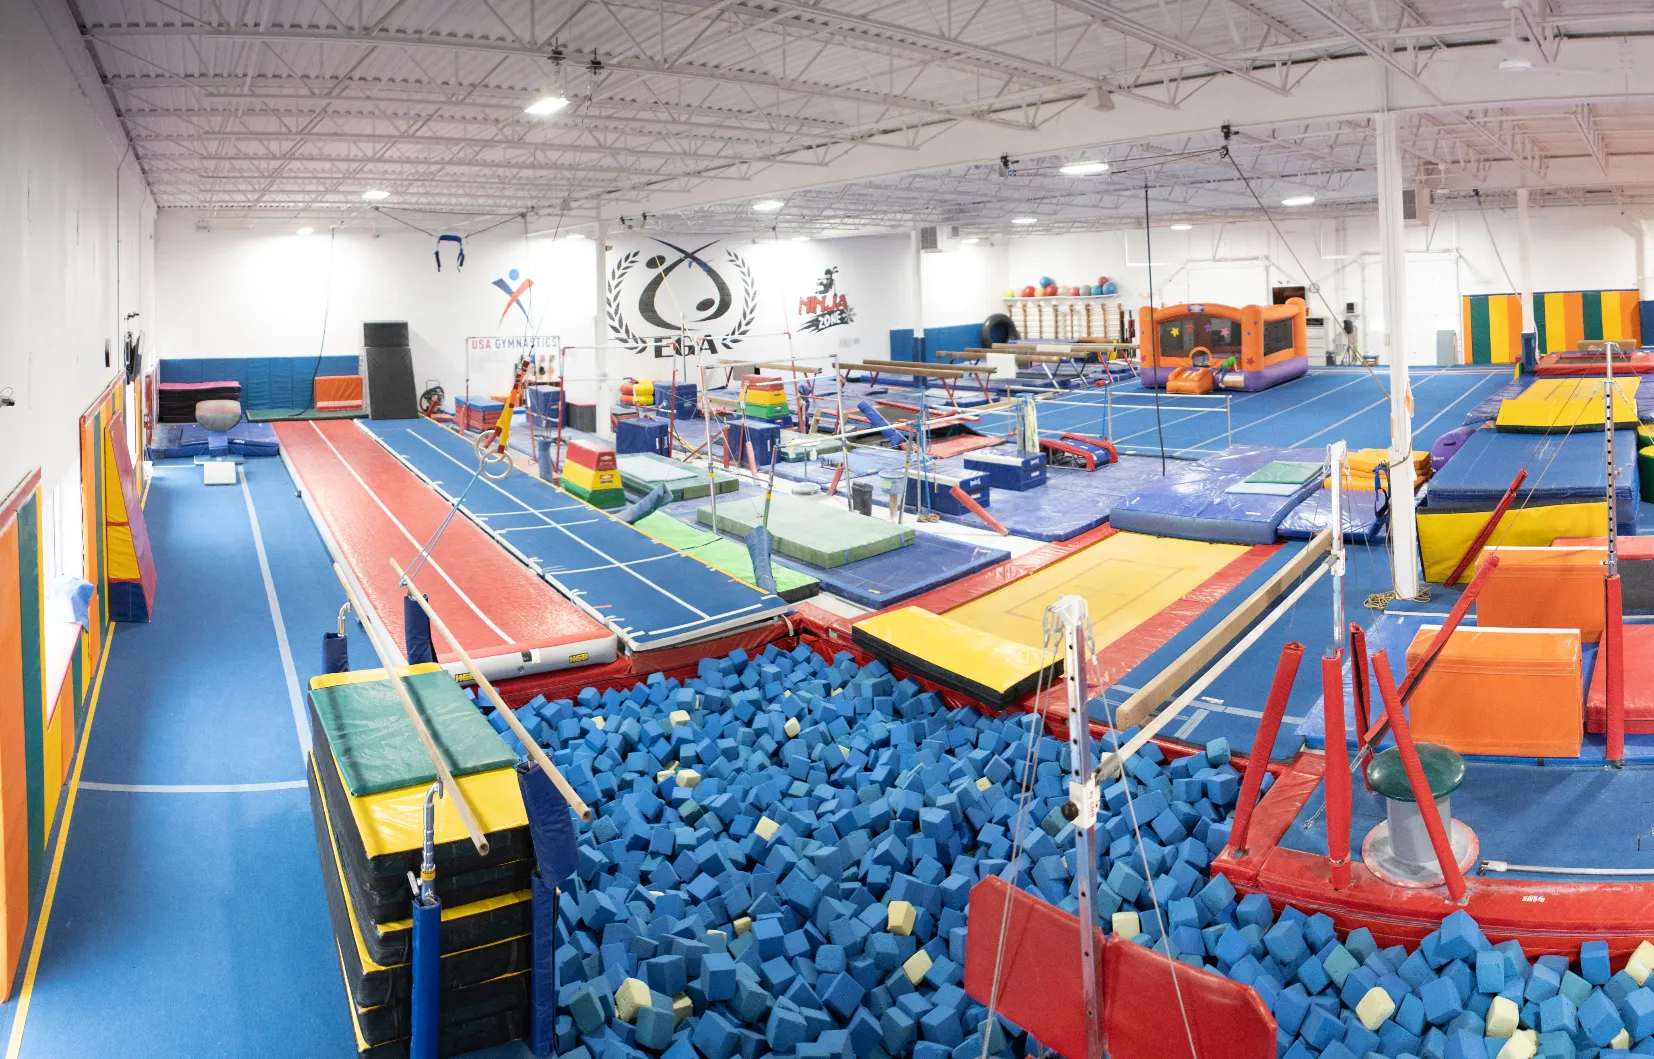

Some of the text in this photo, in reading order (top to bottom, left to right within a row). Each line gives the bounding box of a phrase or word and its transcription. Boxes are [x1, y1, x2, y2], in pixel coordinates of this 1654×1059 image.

[798, 294, 848, 315] NINJA
[818, 311, 842, 329] ZONE
[472, 336, 557, 350] USA GYMNASTICS
[654, 334, 718, 358] EGA
[569, 652, 589, 664] HGB
